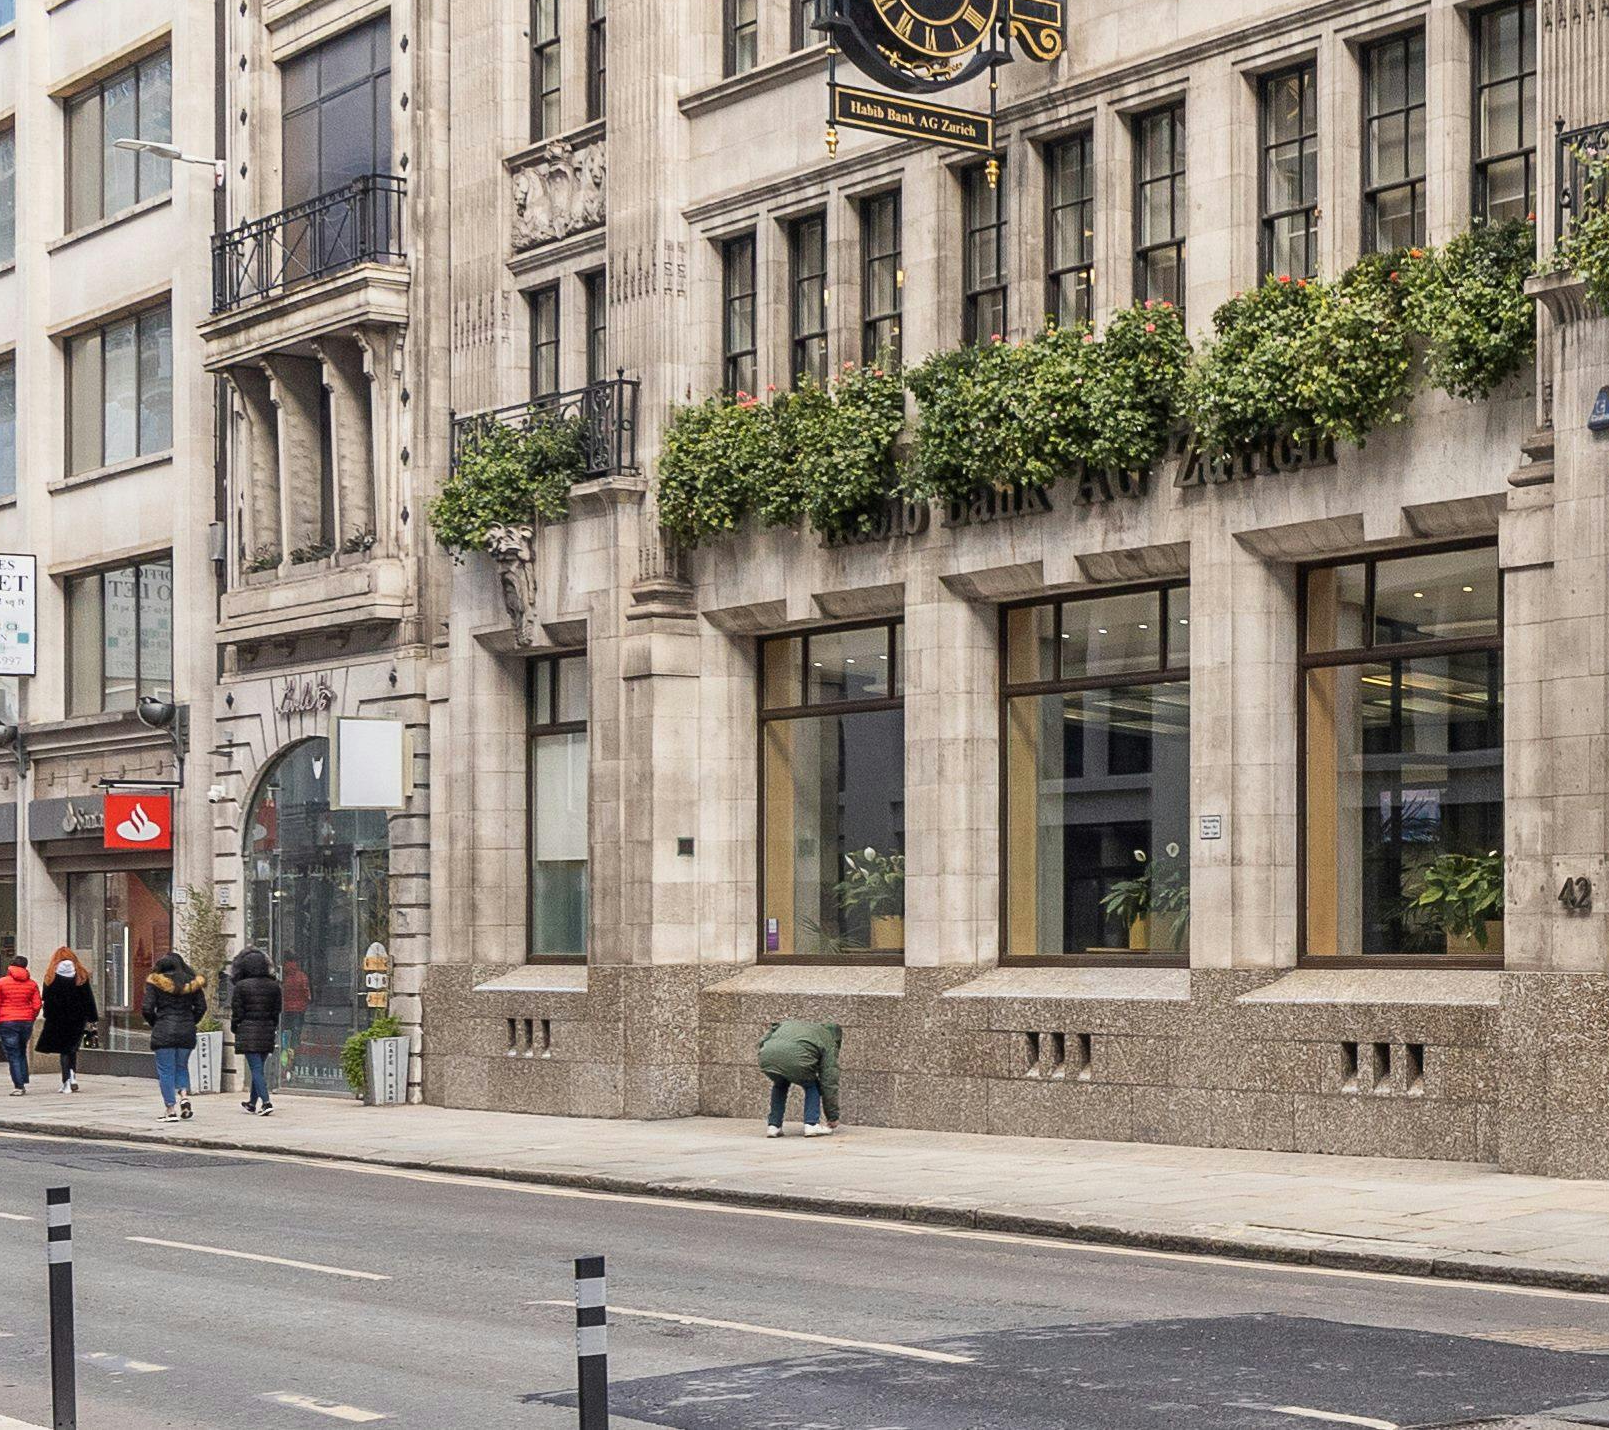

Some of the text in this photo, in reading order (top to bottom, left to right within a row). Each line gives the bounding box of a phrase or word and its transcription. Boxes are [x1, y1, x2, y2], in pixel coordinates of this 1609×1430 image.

[850, 100, 977, 138] Habib Bank AG Zurich
[1558, 876, 1591, 908] 42
